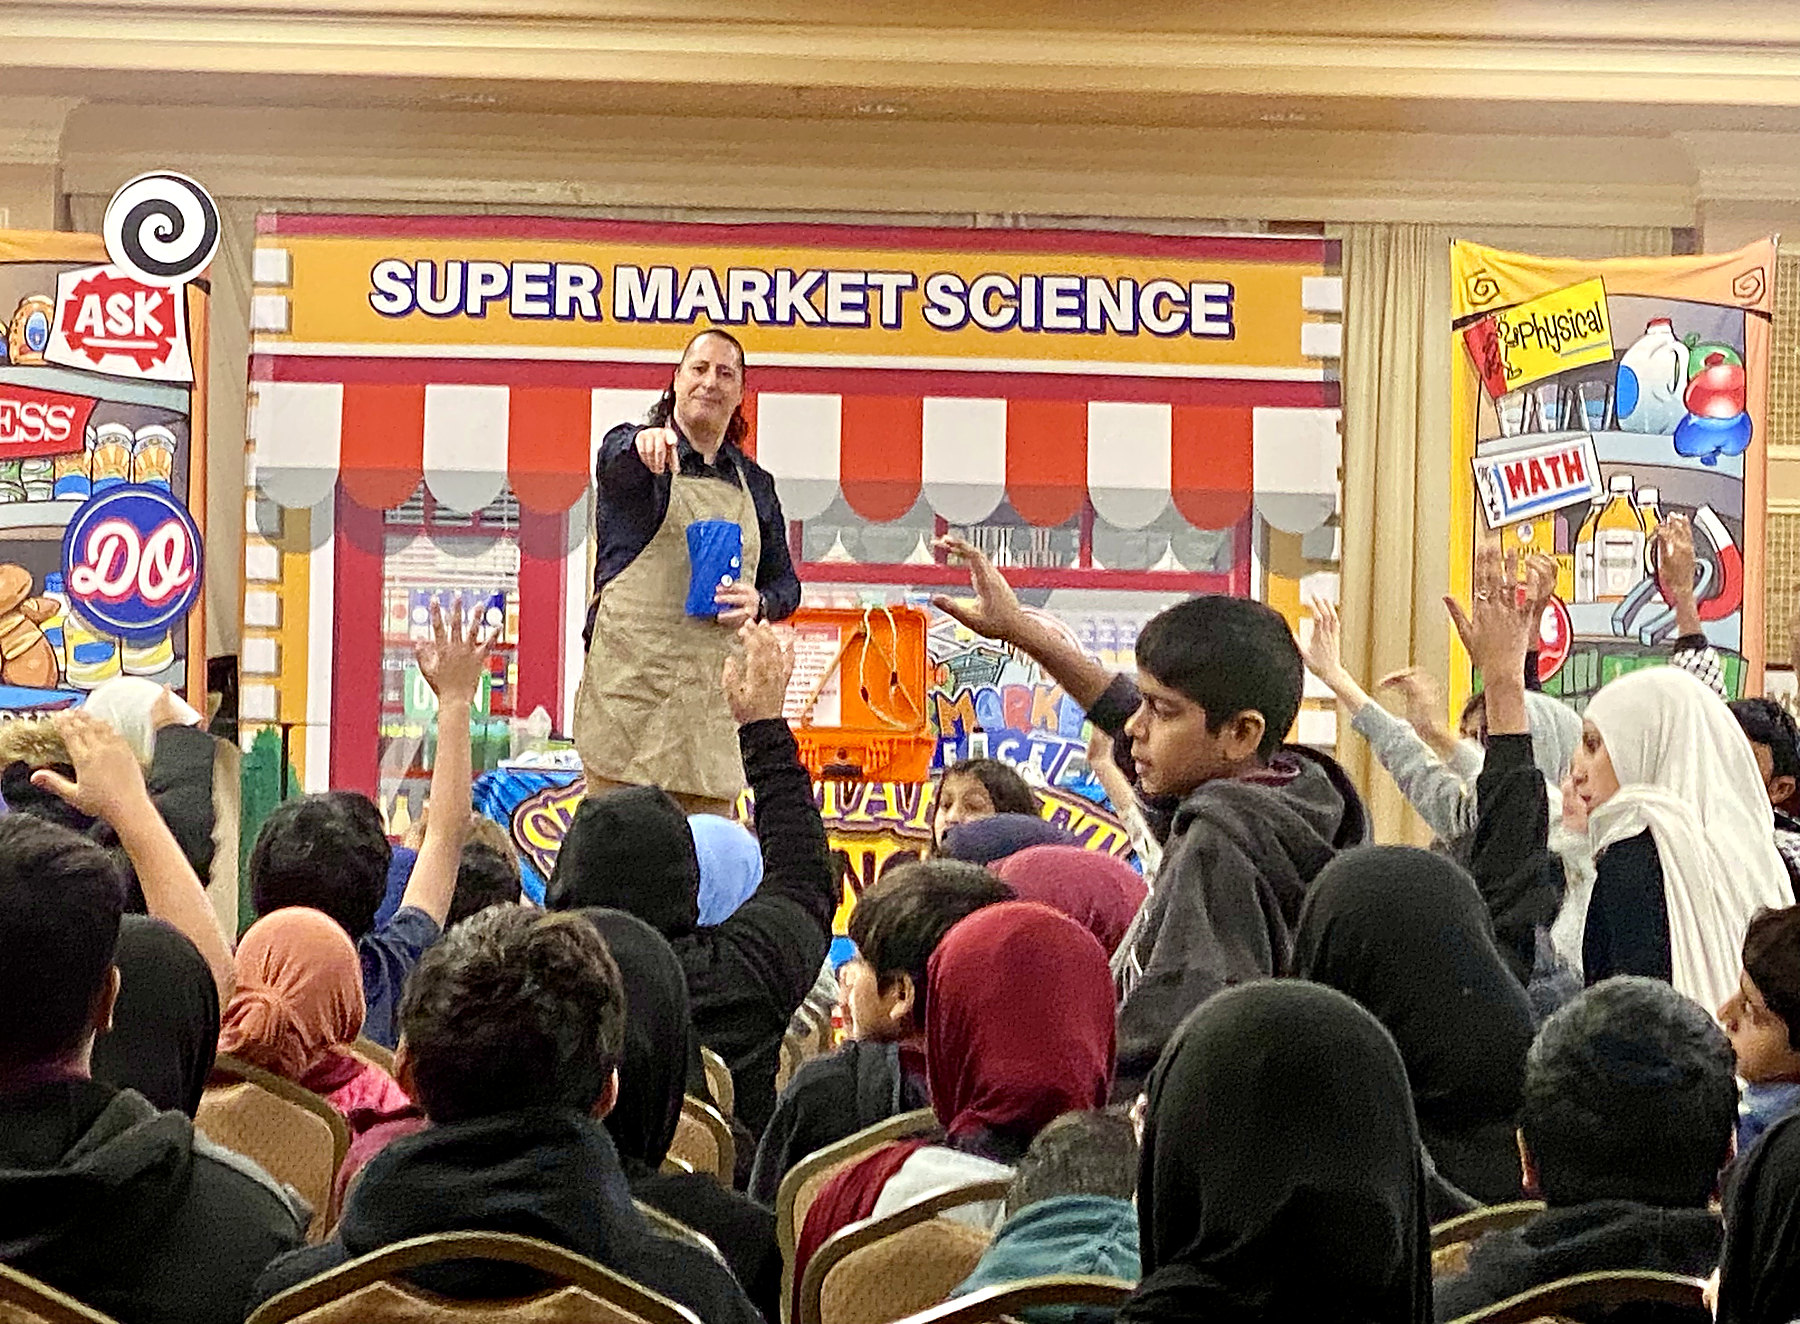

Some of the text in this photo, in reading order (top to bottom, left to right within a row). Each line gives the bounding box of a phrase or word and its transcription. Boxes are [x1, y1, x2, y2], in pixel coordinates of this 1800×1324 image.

[74, 291, 164, 337] ASK
[370, 258, 1235, 340] SUPER MARKET SCIENCE
[1504, 450, 1585, 500] MATH
[70, 518, 192, 603] DO
[936, 684, 1092, 739] MARKE
